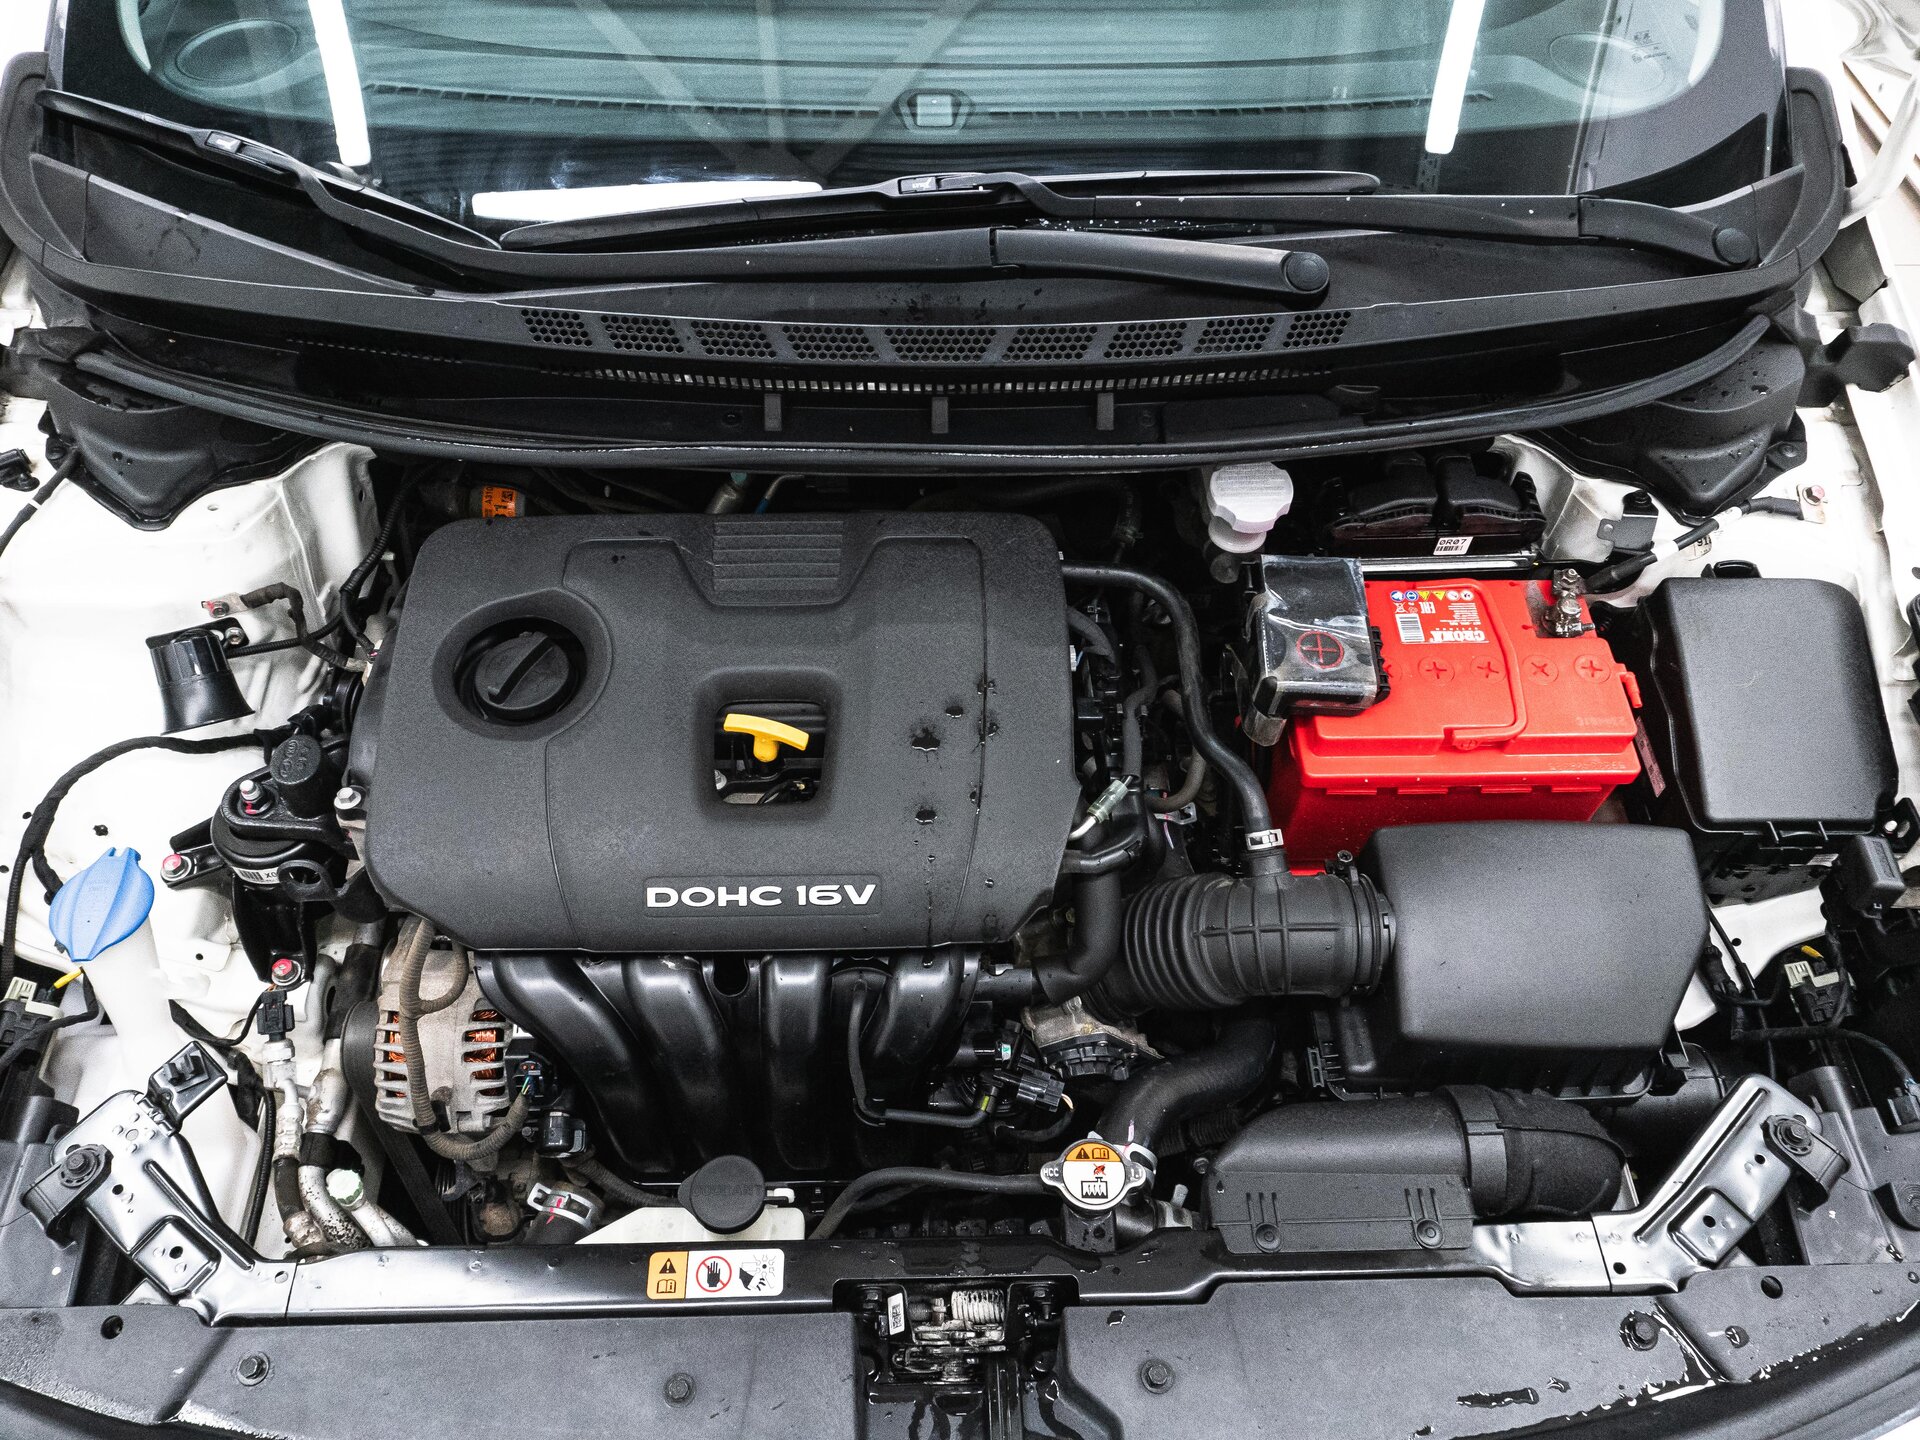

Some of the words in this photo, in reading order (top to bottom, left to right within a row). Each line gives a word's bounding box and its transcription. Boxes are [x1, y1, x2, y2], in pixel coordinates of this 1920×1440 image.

[646, 886, 783, 908] DOHC
[796, 884, 877, 906] 16V
[1043, 1167, 1060, 1177] HCC
